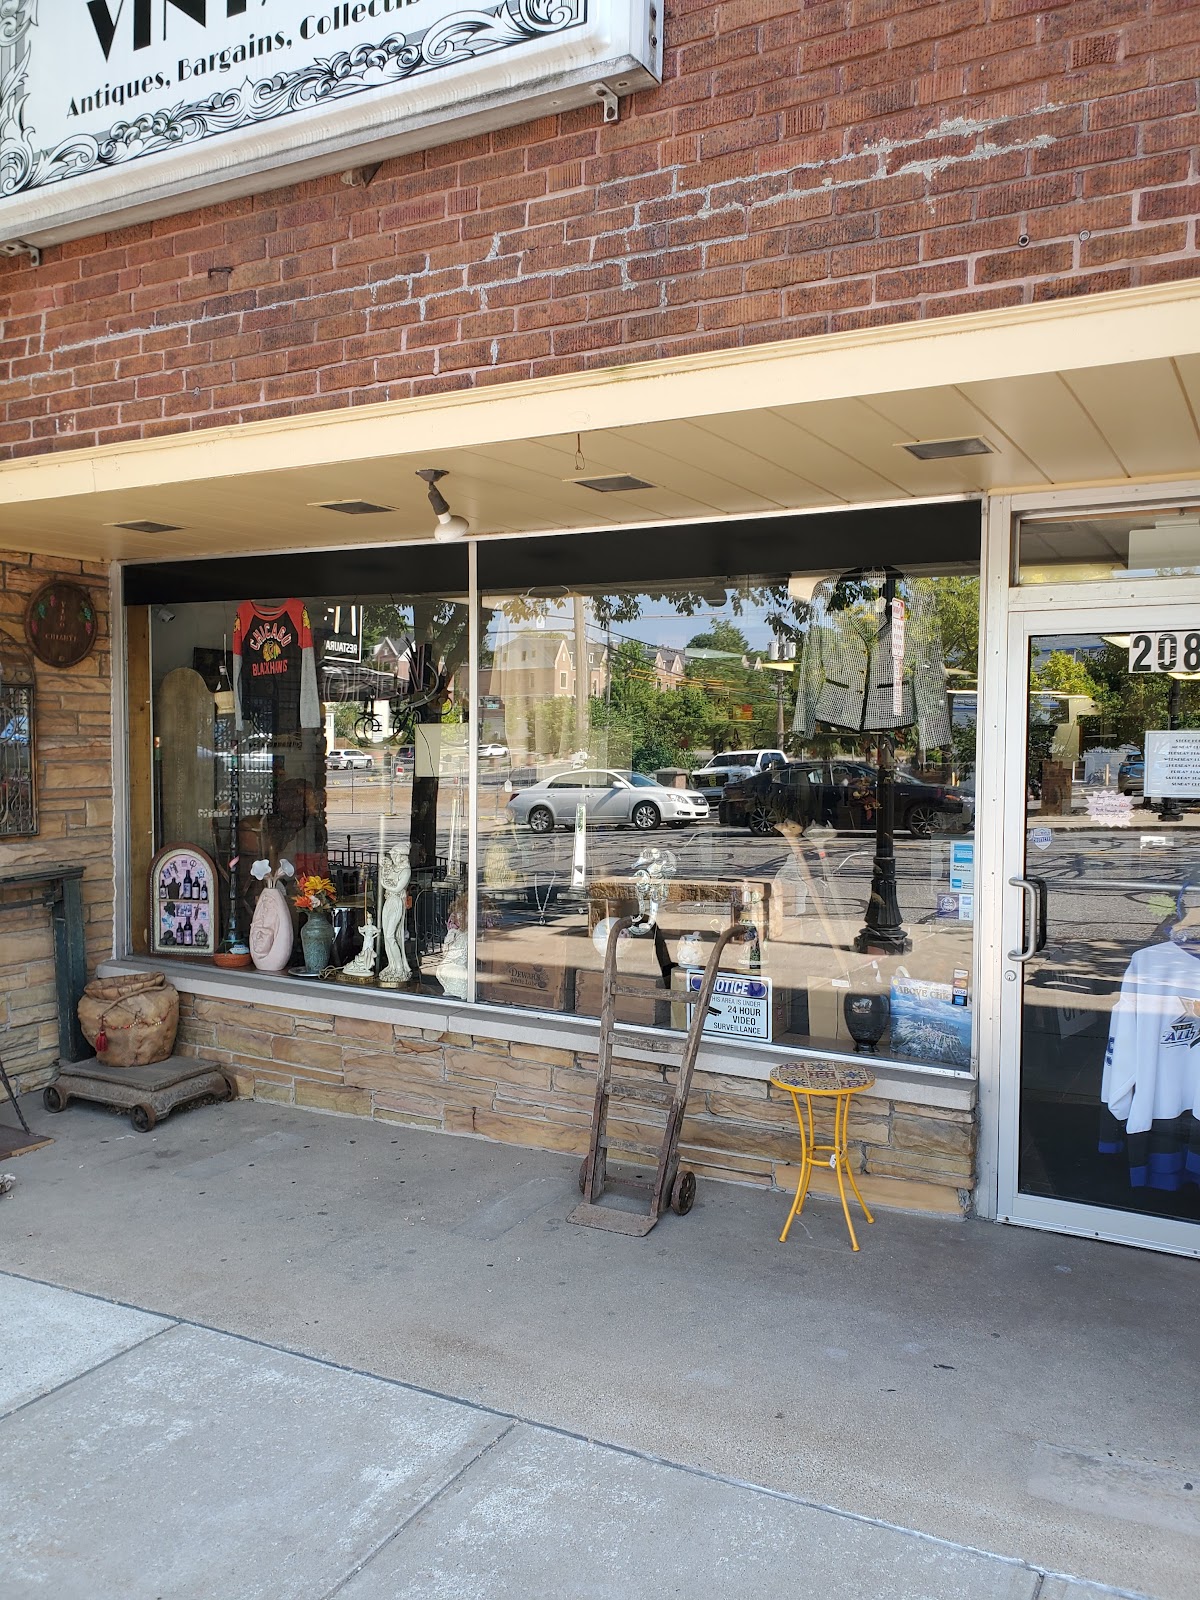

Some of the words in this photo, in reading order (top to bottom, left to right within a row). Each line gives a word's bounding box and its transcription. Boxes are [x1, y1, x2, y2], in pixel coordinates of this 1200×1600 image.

[87, 0, 264, 62] VIN
[66, 71, 171, 119] Antiques,
[178, 31, 293, 82] Bargains,
[249, 622, 292, 650] CHICAGO
[1132, 633, 1200, 672] 208
[713, 979, 750, 995] OTICE
[896, 985, 928, 998] ABOVE
[743, 999, 761, 1007] UNDER
[727, 1005, 737, 1014] 24
[739, 1007, 761, 1017] HOUR
[713, 1021, 761, 1035] SURVEILLANCE
[732, 1015, 756, 1026] VIDEO
